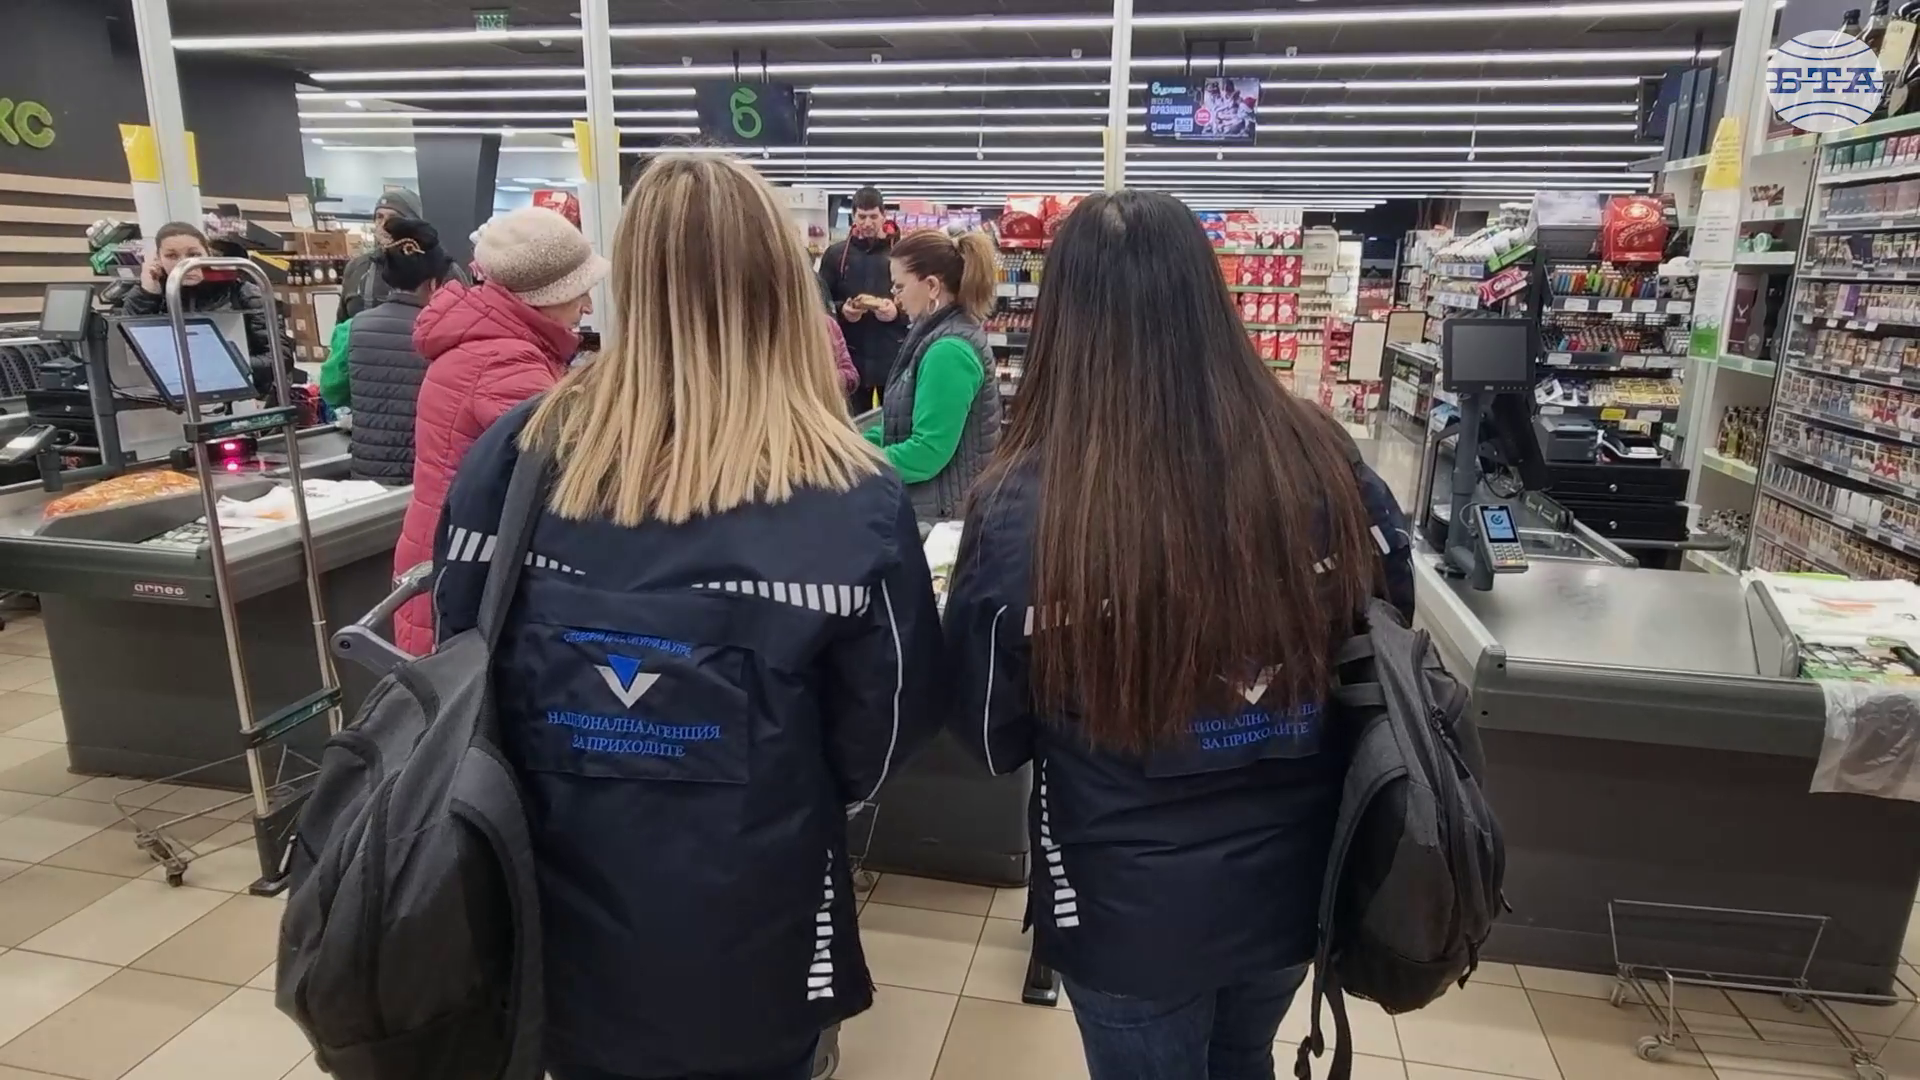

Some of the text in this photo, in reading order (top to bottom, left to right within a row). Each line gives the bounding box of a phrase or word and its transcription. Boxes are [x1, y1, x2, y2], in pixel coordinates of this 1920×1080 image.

[547, 711, 721, 740] НАЦИОНАЛНА АГЕНЦИЯ
[587, 736, 686, 757] ПРИХОДИТЕ
[1201, 737, 1220, 750] ЗА
